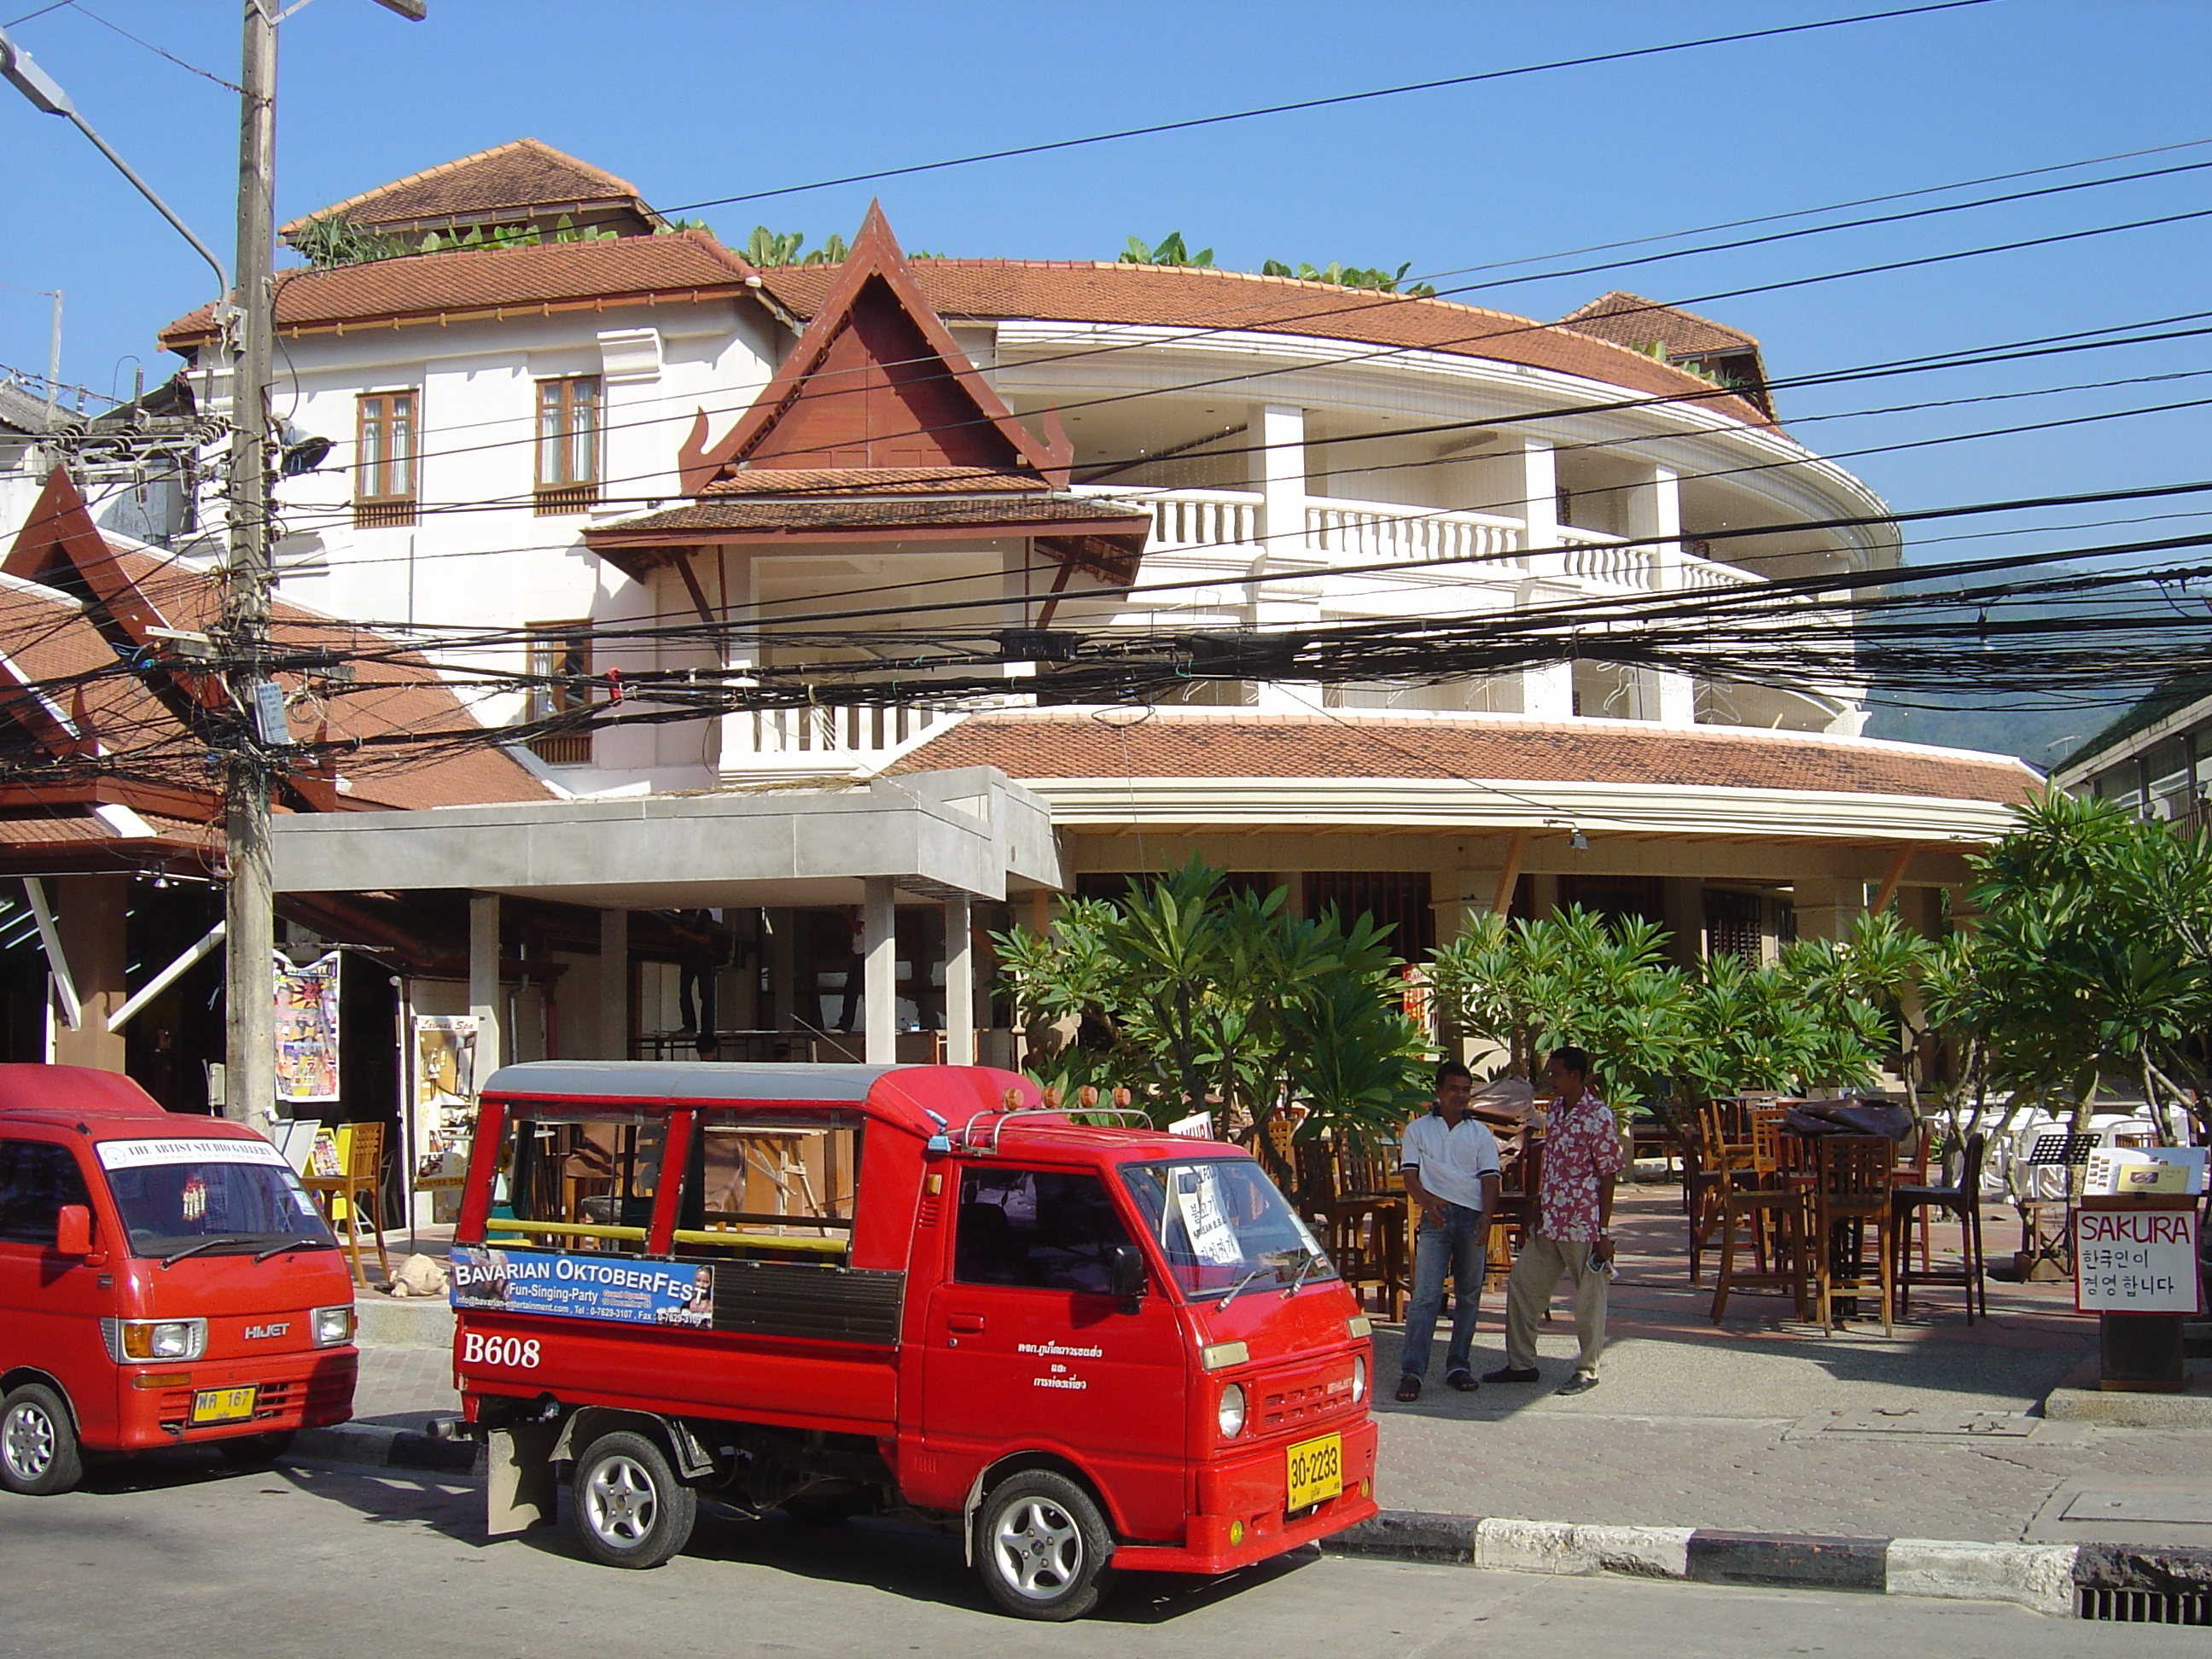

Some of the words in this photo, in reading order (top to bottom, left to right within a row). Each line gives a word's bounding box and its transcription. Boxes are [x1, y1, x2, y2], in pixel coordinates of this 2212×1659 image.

[127, 1146, 151, 1155] THE
[154, 1144, 192, 1153] ARTIST
[194, 1144, 231, 1152] STUDIO
[231, 1144, 271, 1156] GALLERY
[2081, 1215, 2190, 1244] SAKURA
[2082, 1249, 2148, 1270] 한국인이
[455, 1262, 550, 1286] BAVARIAN
[456, 1295, 569, 1313] info@bavarian-entertainment.com
[509, 1283, 598, 1306] Fun-Singing-Party
[244, 1323, 290, 1340] HIJET
[463, 1333, 540, 1369] B608
[227, 1390, 249, 1407] 167
[1291, 1447, 1337, 1489] 30-2233
